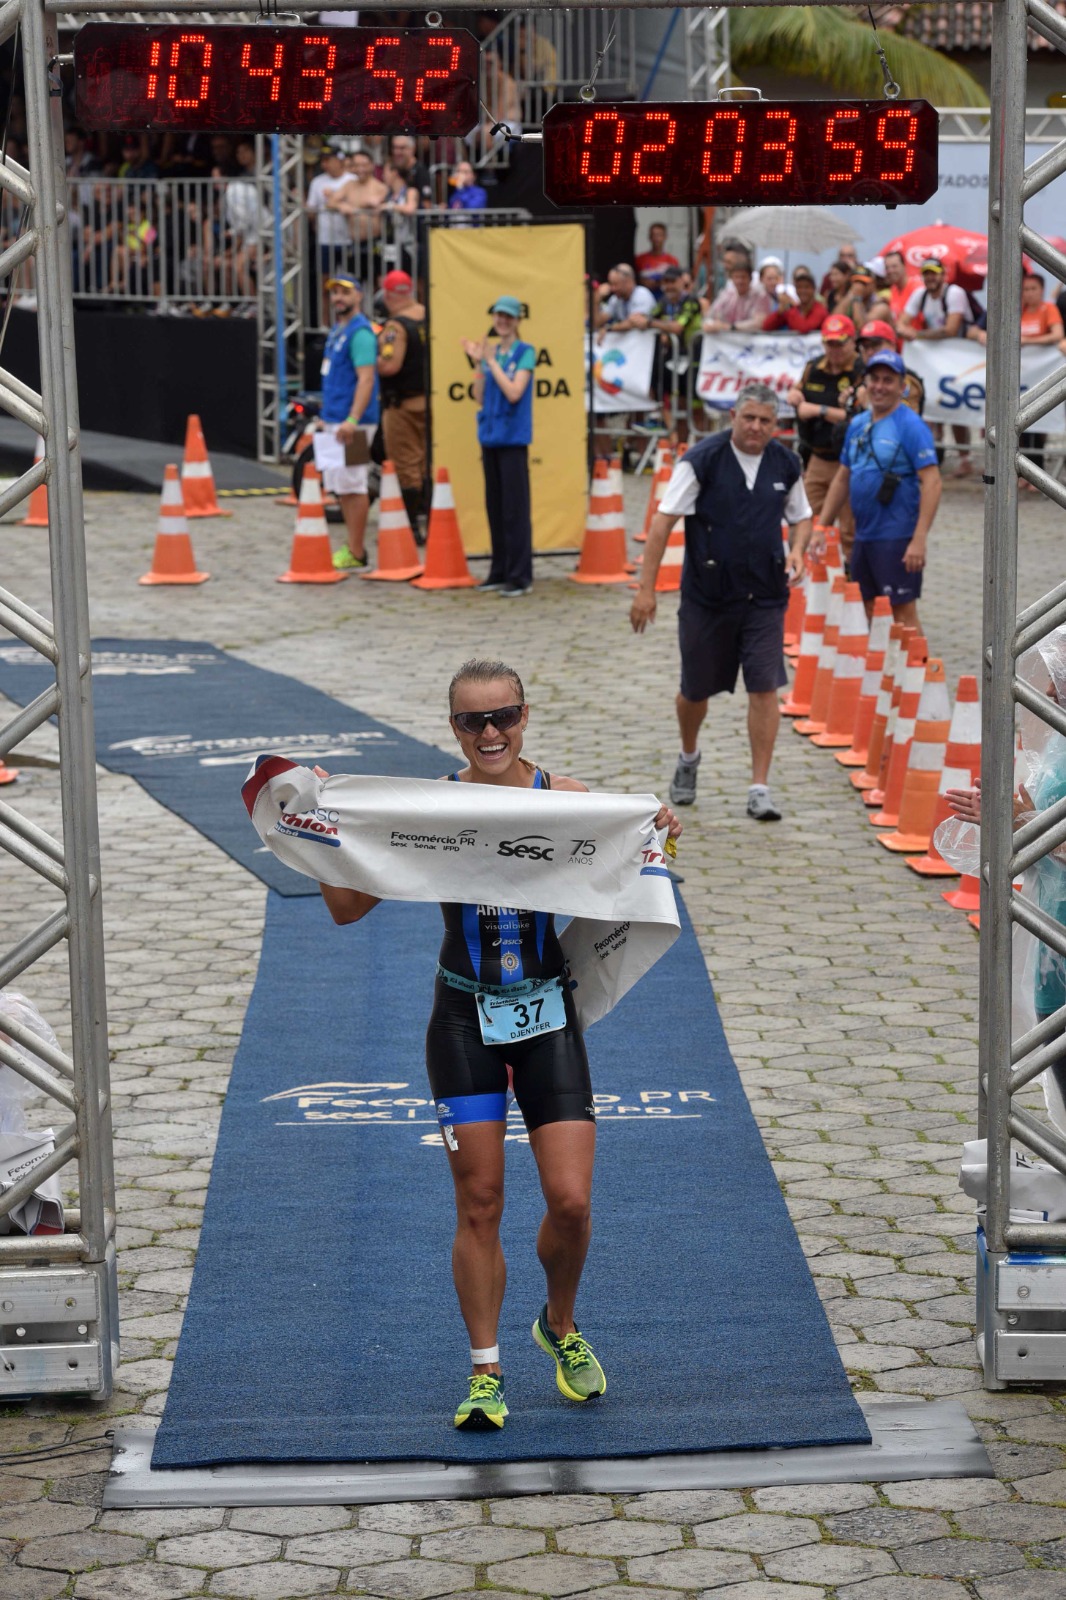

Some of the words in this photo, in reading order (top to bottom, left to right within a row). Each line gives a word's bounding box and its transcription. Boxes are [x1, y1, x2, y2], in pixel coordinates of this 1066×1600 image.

[147, 34, 213, 108] 10
[241, 36, 337, 110] 43
[365, 37, 461, 110] 52
[581, 111, 677, 183] 02
[702, 111, 797, 182] 03
[826, 110, 918, 181] 59
[938, 376, 987, 411] Se
[390, 831, 457, 845] Fecomércio
[459, 837, 476, 846] PR
[414, 842, 437, 850] Senac
[570, 839, 596, 856] 75
[496, 840, 555, 862] Sesc
[567, 857, 594, 866] ANOS
[484, 920, 530, 931] visualbike
[594, 921, 631, 953] Fecomérci
[513, 997, 545, 1029] 37
[510, 1021, 551, 1039] DJENYFER
[639, 1090, 718, 1103] PR
